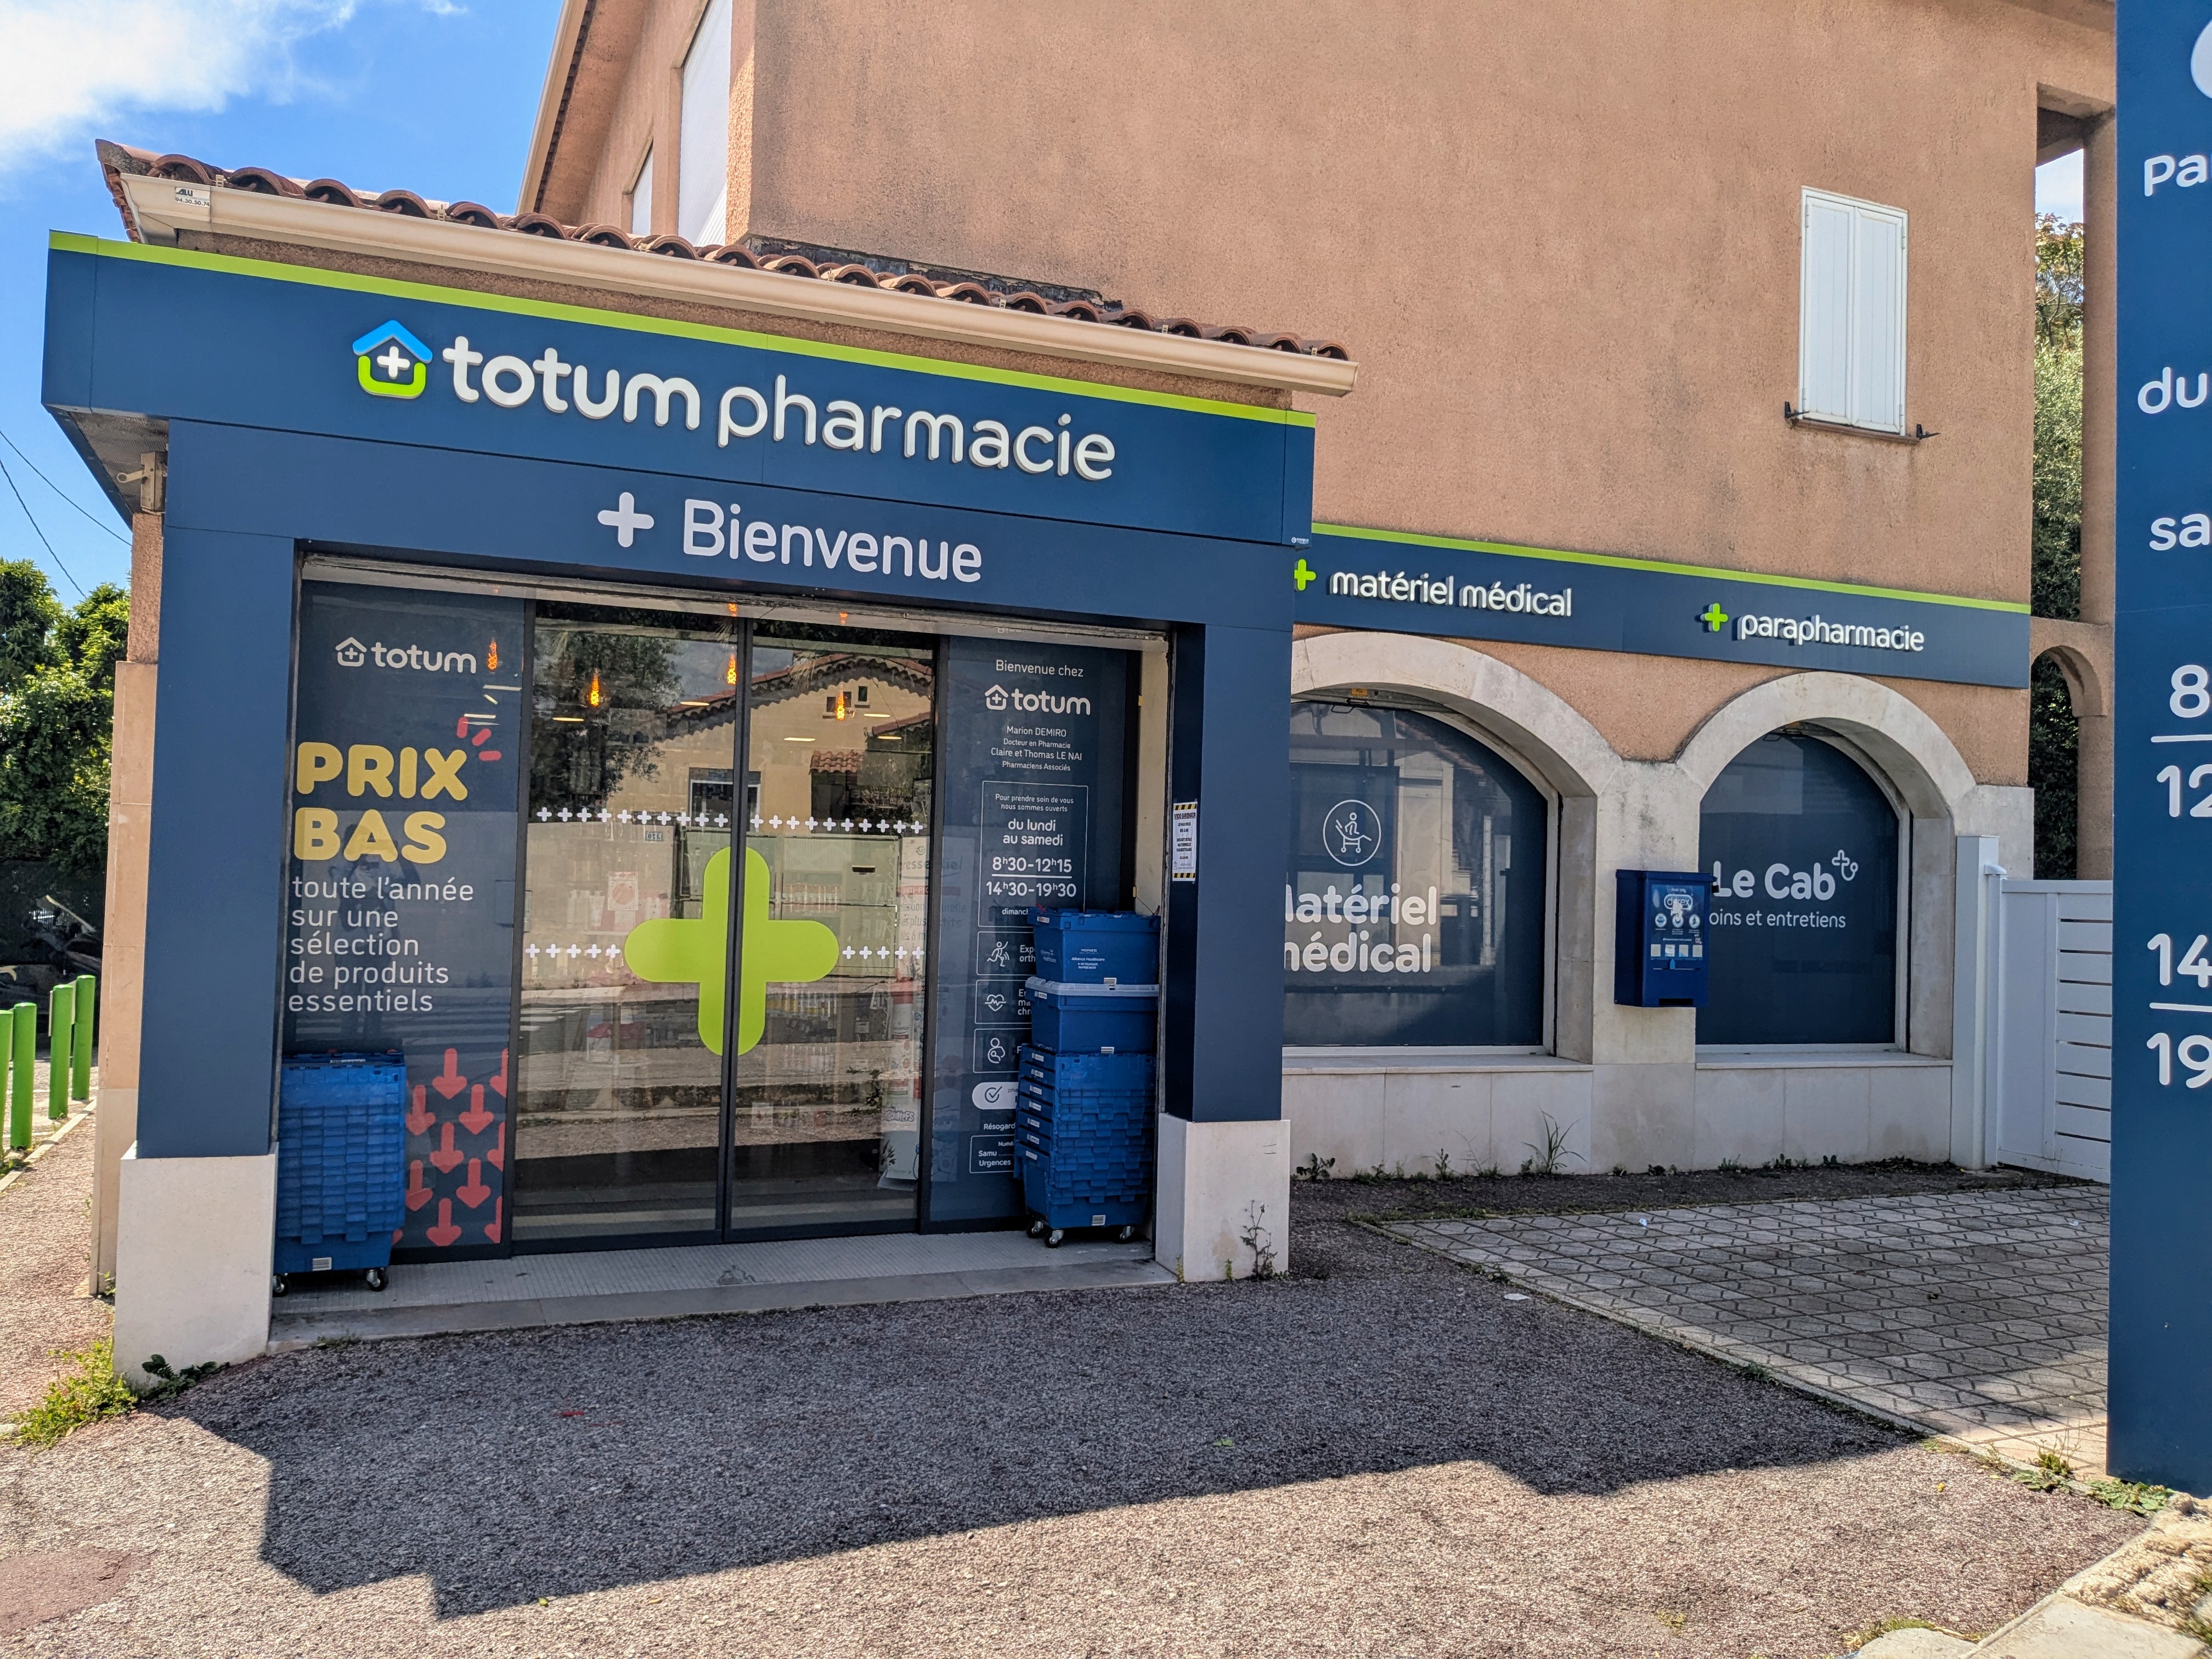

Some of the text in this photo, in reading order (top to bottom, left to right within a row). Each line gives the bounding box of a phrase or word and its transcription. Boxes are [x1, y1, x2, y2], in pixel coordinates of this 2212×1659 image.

[2144, 155, 2212, 196] pa
[176, 188, 193, 196] ALU
[2138, 366, 2208, 414] du
[442, 336, 1116, 481] totum pharmacie
[683, 498, 982, 583] Bienvenue
[2149, 514, 2212, 551] sa
[1330, 570, 1572, 617] matériel médical
[1737, 614, 1925, 652] parapharmacie
[371, 642, 477, 674] totum
[996, 659, 1084, 677] Bienvenue chez
[1011, 689, 1091, 715] totum
[1007, 726, 1066, 737] Marion DEMIRO
[991, 748, 1013, 757] Claire
[1024, 749, 1054, 759] Thomas
[1057, 751, 1066, 759] LE
[1003, 738, 1028, 747] Docteur
[1038, 741, 1071, 749] Pharmacie
[296, 742, 468, 801] PRIX
[1002, 761, 1042, 769] Pharmaciens
[1011, 794, 1035, 803] prendre
[294, 808, 447, 864] BAS
[1008, 818, 1056, 832] du lundi
[1003, 834, 1063, 846] au samedi
[291, 876, 366, 899] toute
[1713, 861, 1836, 901] Le Cab
[291, 908, 398, 927] sur une
[1708, 910, 1846, 928] oins et entretiens
[290, 930, 419, 956] sélection
[1020, 944, 1036, 955] Exp
[290, 961, 449, 990] de produits
[289, 989, 433, 1012] essentiels
[983, 1122, 1015, 1131] Résogard
[979, 1159, 1012, 1168] Urgences
